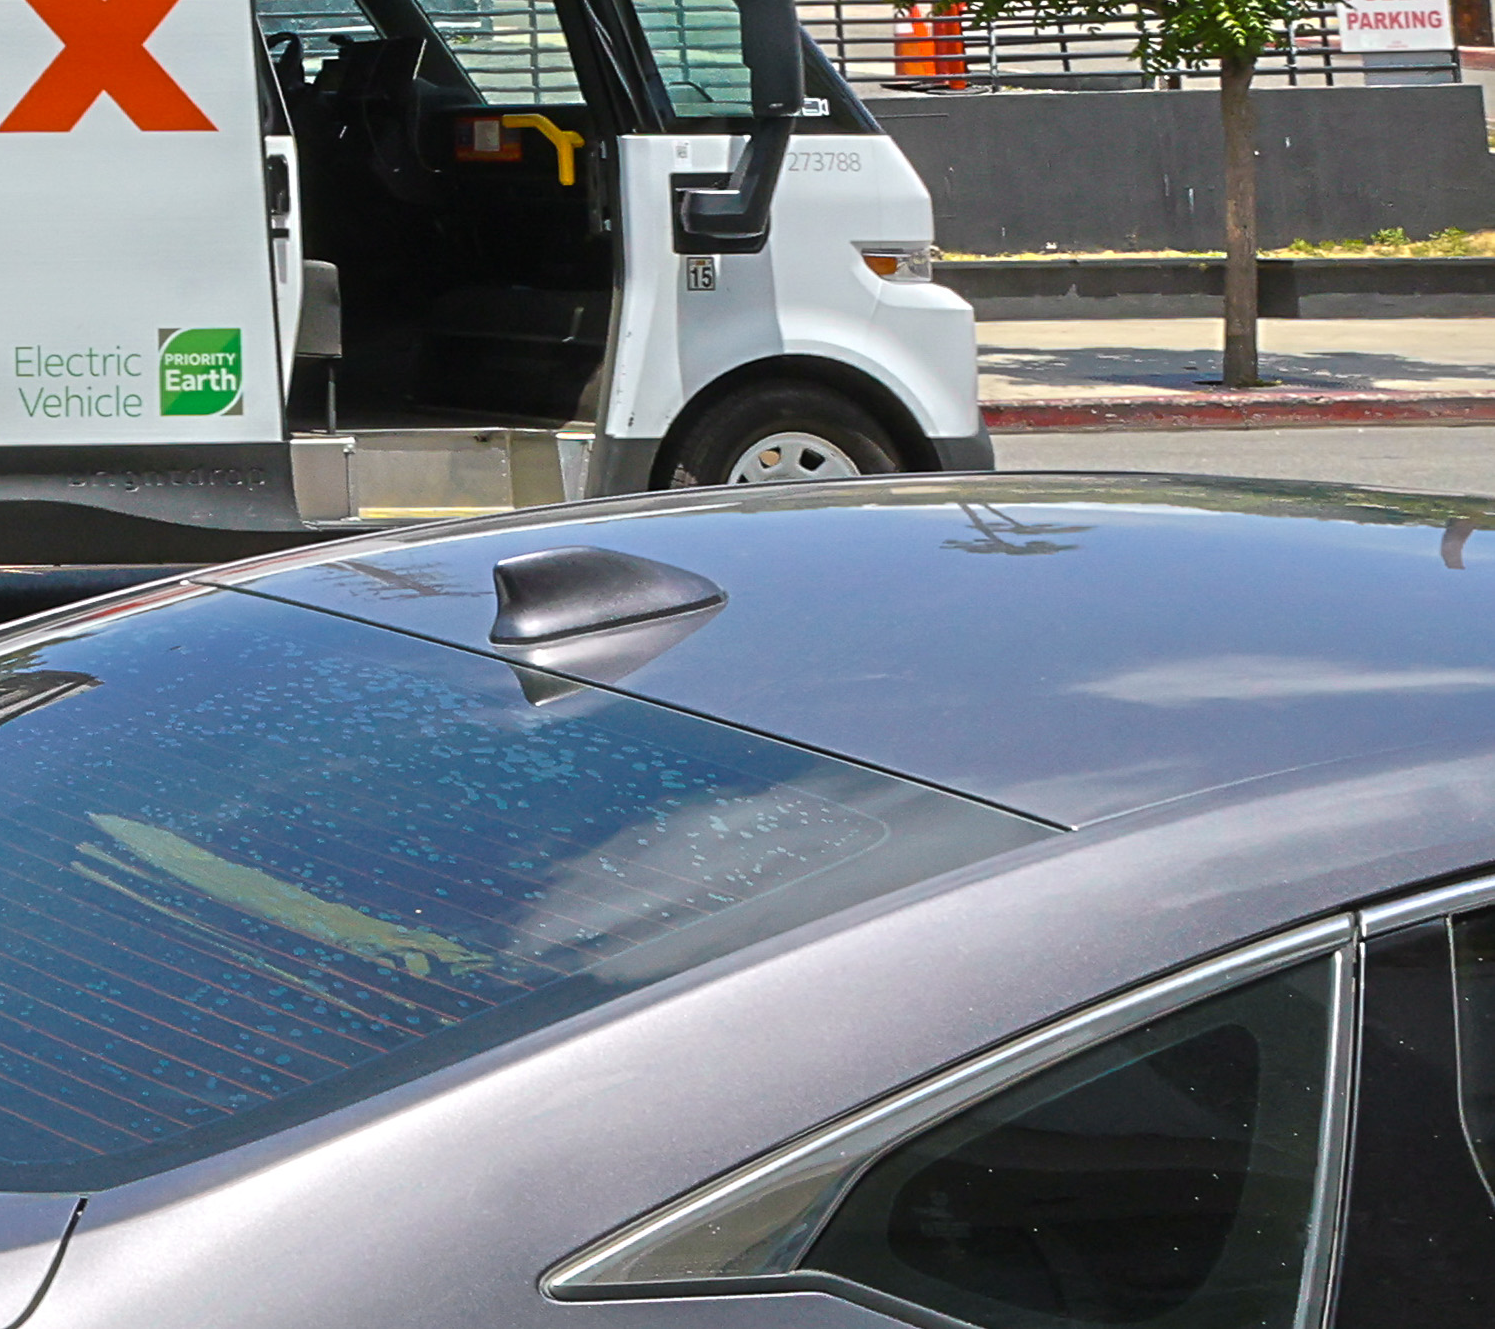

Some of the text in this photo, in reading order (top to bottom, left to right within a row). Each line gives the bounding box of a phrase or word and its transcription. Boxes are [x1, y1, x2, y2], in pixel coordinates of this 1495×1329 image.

[1346, 10, 1443, 30] PARKING
[787, 151, 862, 173] 273788
[690, 266, 712, 288] 15
[14, 345, 142, 378] Electric
[164, 352, 236, 366] PRIORITY
[165, 368, 237, 391] Earth
[18, 385, 143, 418] Vehicle
